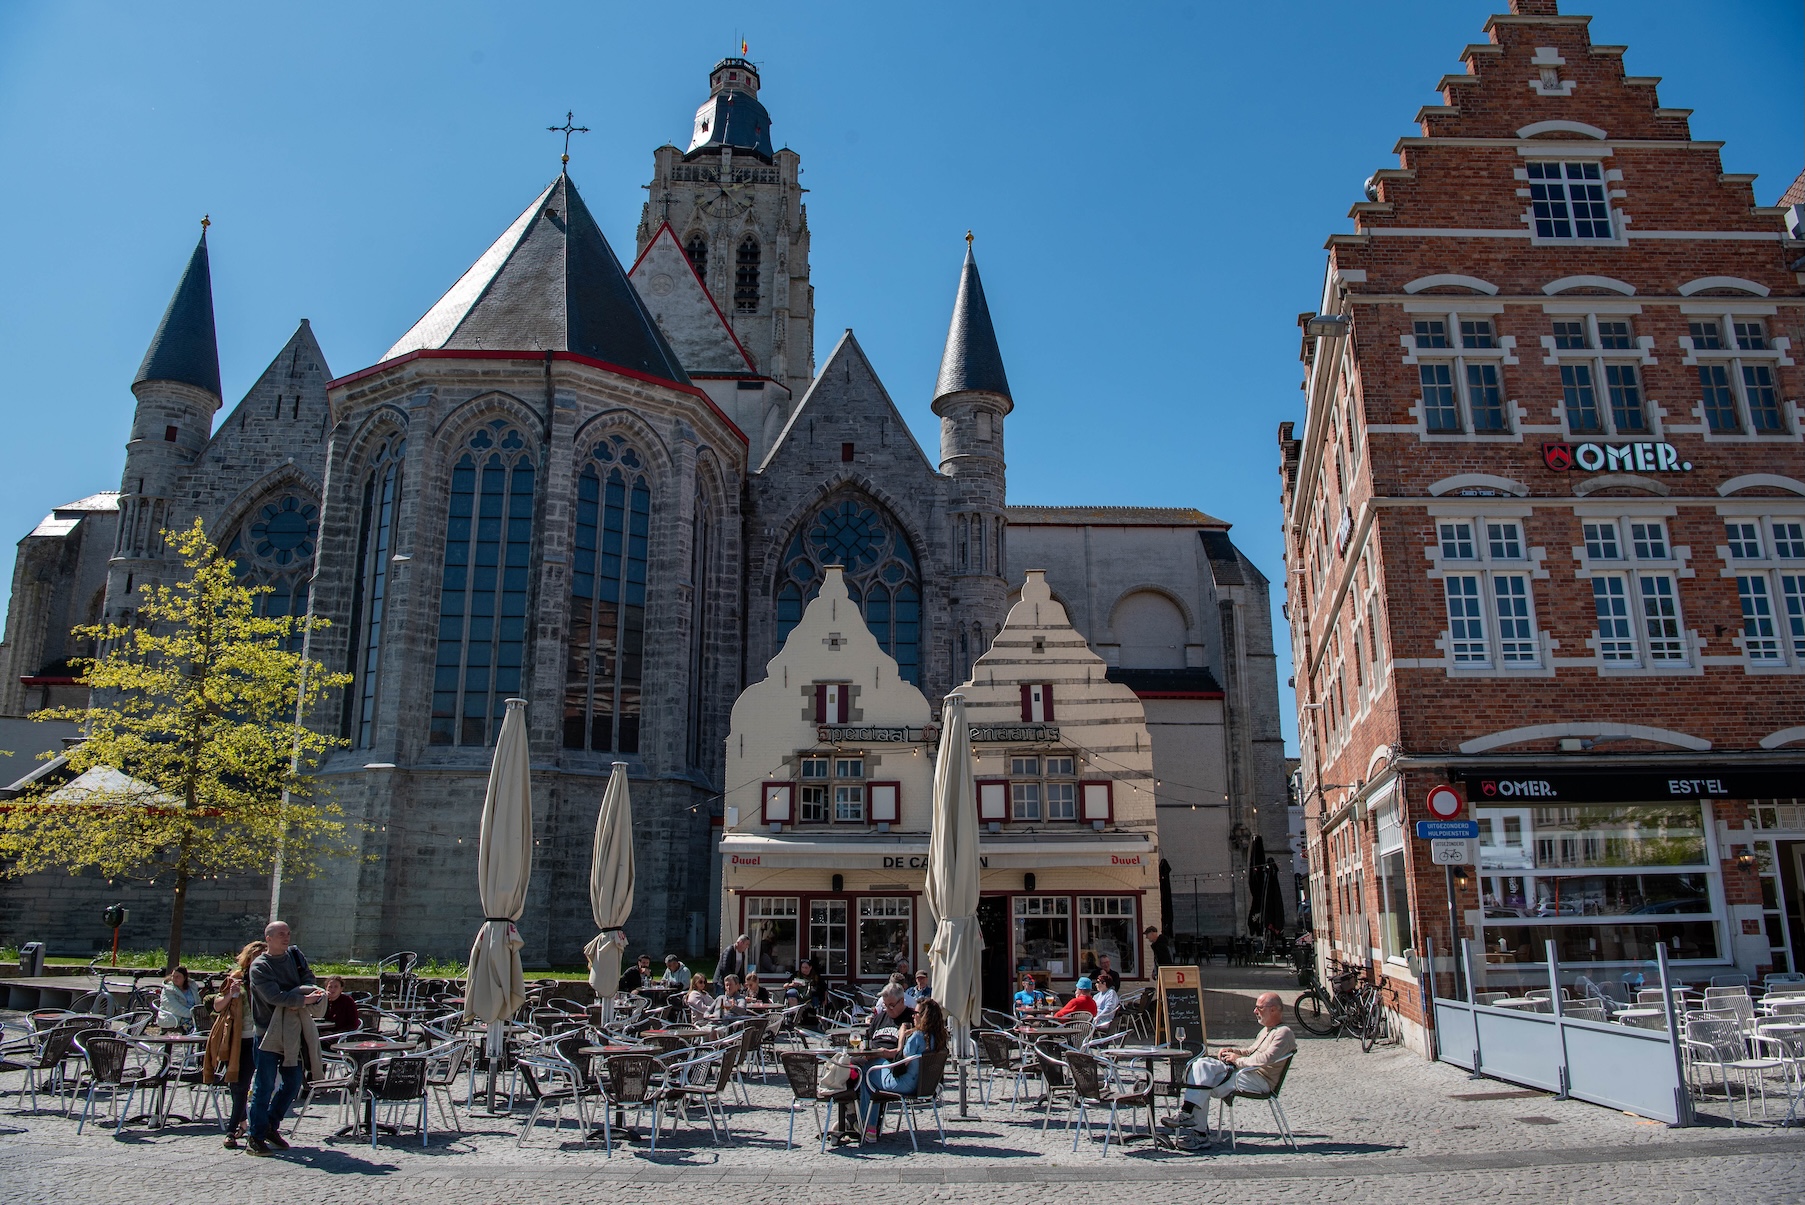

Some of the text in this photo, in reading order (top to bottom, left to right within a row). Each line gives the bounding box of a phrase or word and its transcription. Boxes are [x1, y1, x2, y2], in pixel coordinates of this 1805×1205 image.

[1575, 442, 1693, 473] OMER.
[817, 724, 910, 745] Speciaal
[1499, 780, 1558, 796] OMER.
[1668, 779, 1729, 794] EST'EL
[731, 855, 761, 866] Duvel
[882, 856, 905, 868] DE
[1111, 855, 1141, 865] Duvel
